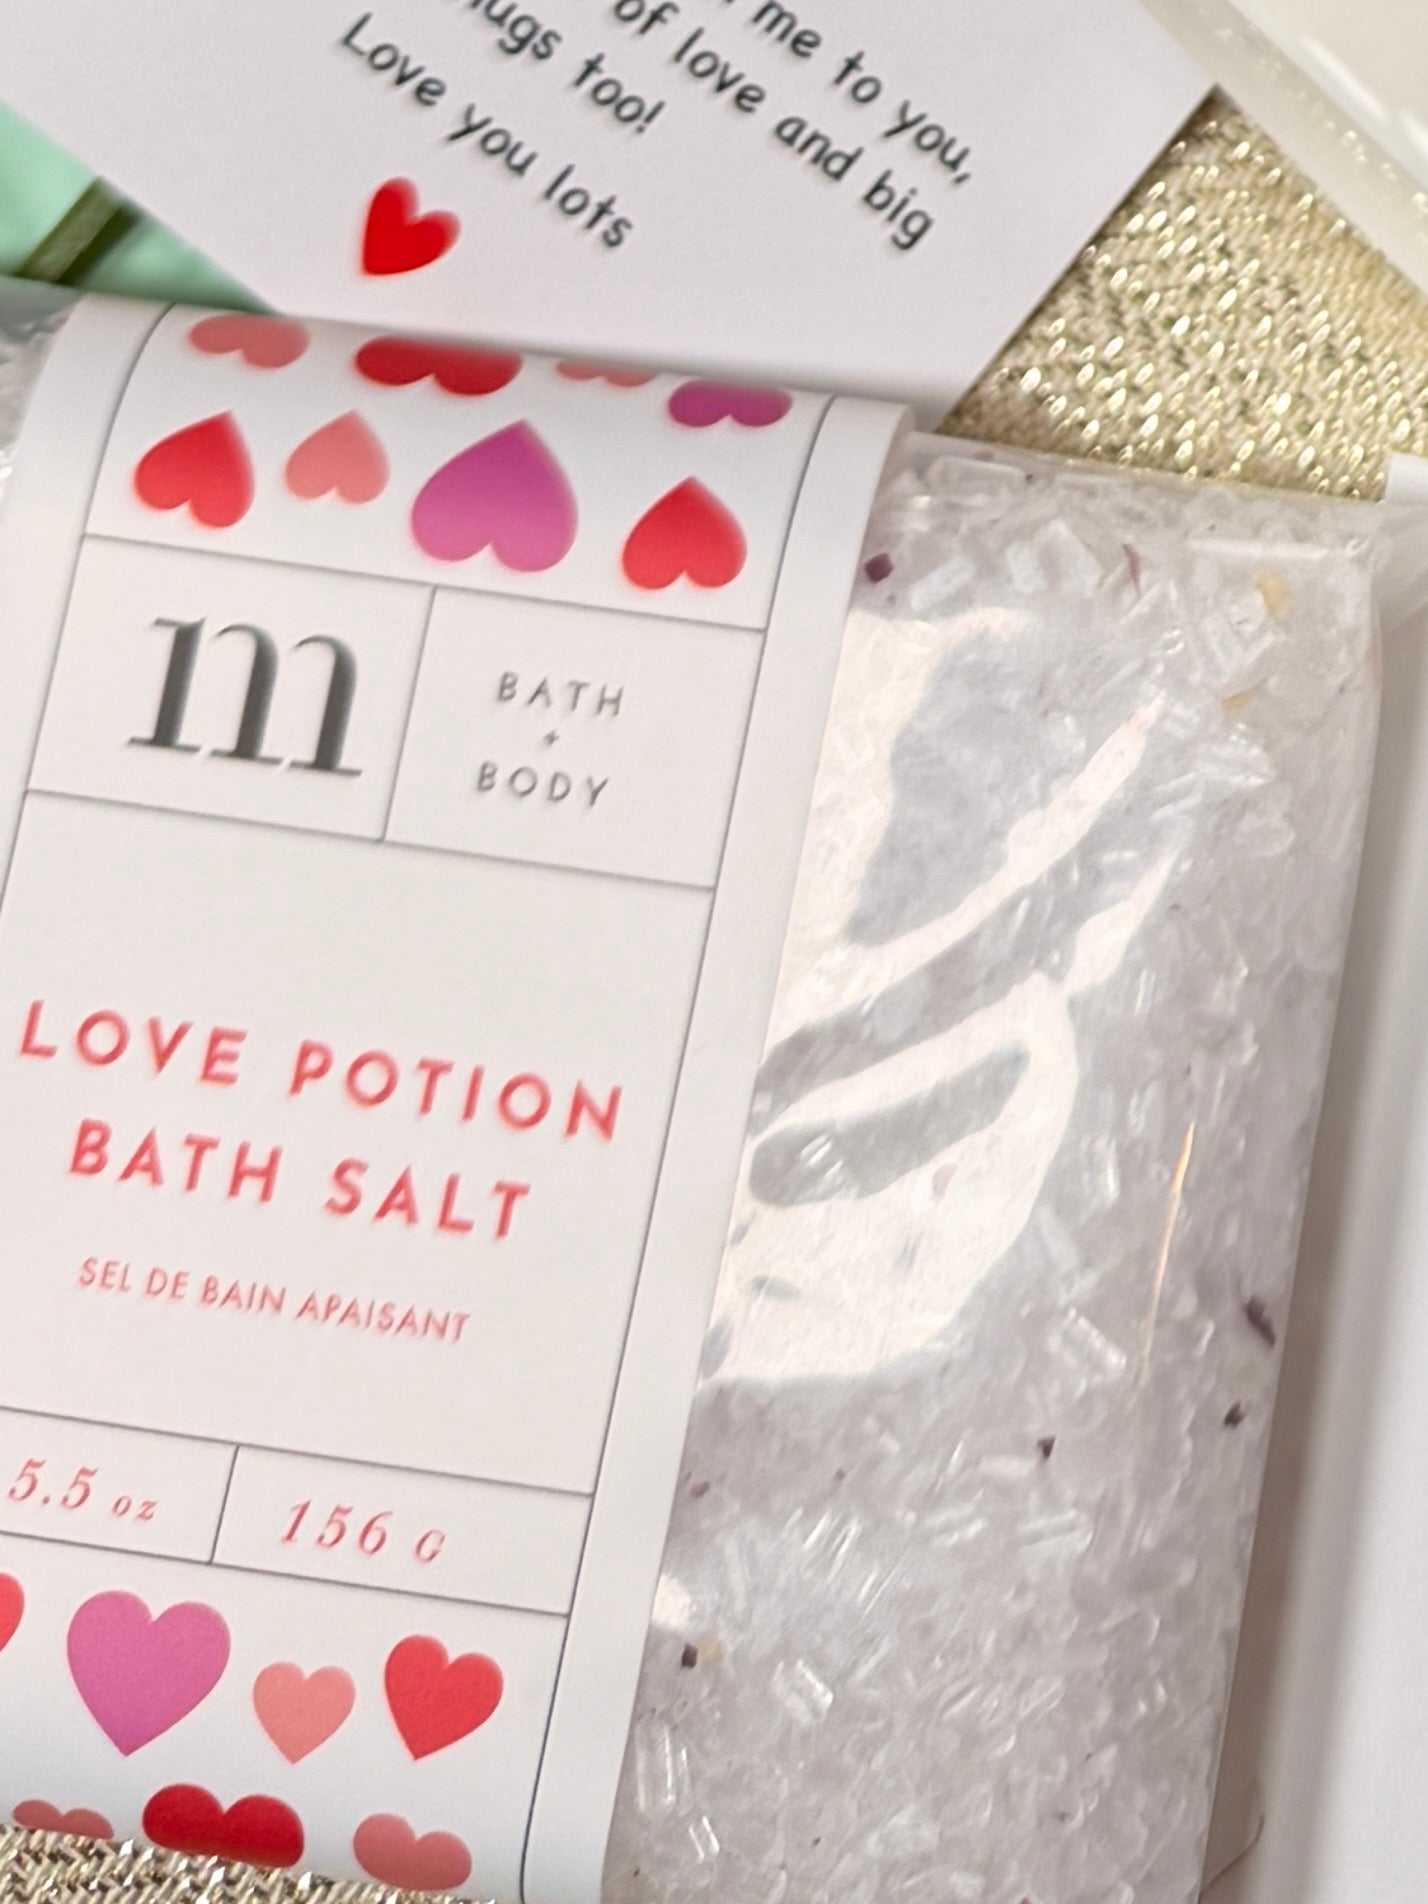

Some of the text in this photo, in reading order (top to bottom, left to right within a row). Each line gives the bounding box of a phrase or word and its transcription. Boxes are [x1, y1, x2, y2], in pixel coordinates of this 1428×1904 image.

[338, 12, 633, 249] Love you lots
[571, 52, 666, 135] too!
[670, 27, 766, 114] love
[772, 116, 865, 182] and
[861, 169, 934, 253] big
[831, 51, 882, 105] to
[882, 100, 972, 187] you,
[495, 671, 624, 719] BATH
[474, 760, 609, 810] BODY
[16, 998, 623, 1144] LOVE POTION
[67, 1118, 532, 1242] BATH SALT
[77, 1257, 471, 1343] SEL DE BAIN APAISANT
[7, 1457, 97, 1512] 5.5
[279, 1500, 392, 1561] 156
